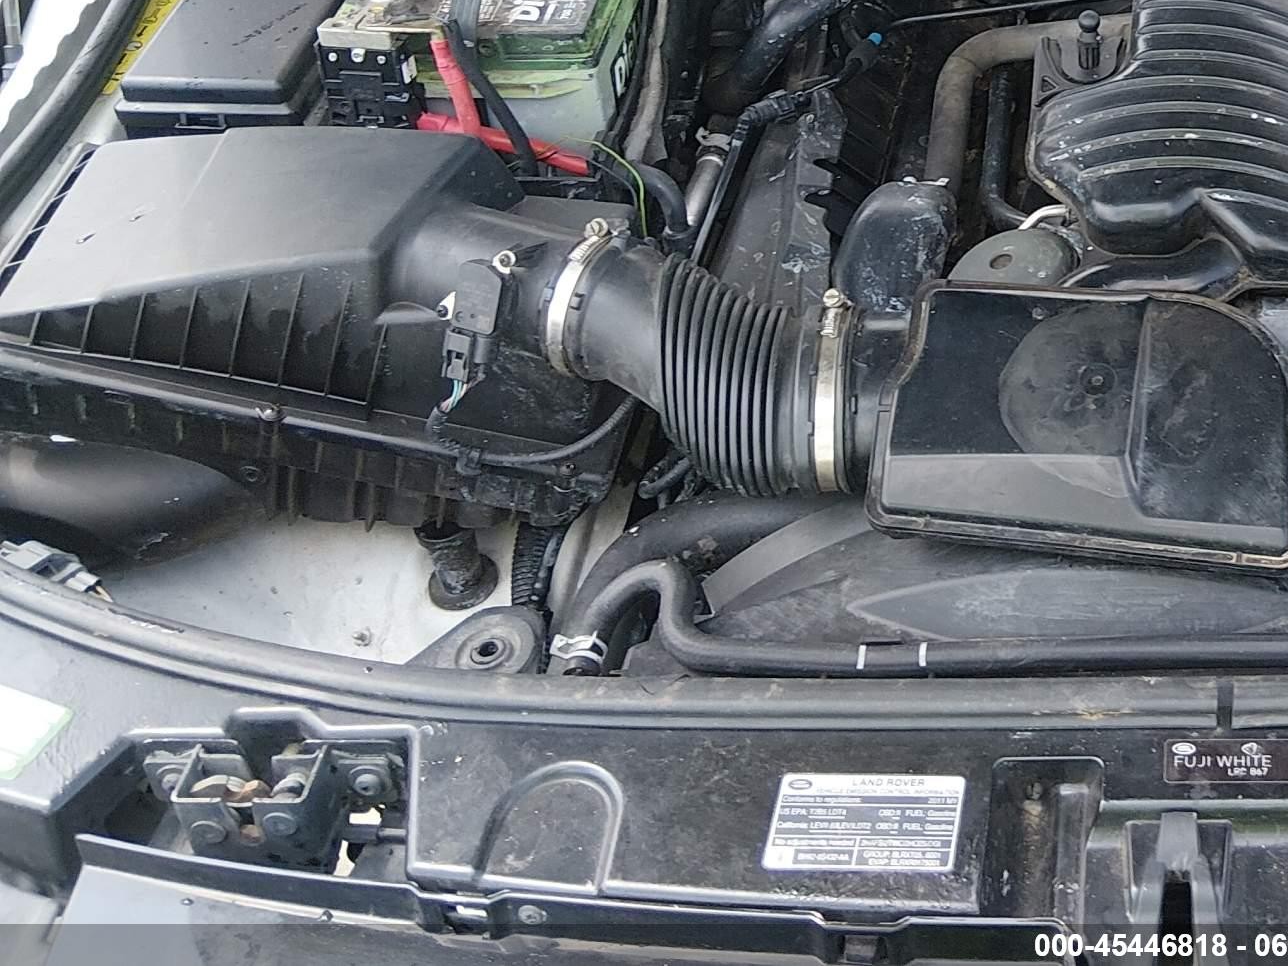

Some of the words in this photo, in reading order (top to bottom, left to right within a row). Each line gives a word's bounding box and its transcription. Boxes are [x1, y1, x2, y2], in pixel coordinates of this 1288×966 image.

[1174, 755, 1212, 768] FUJI
[1216, 755, 1272, 768] WHITE
[887, 779, 925, 787] ROVER
